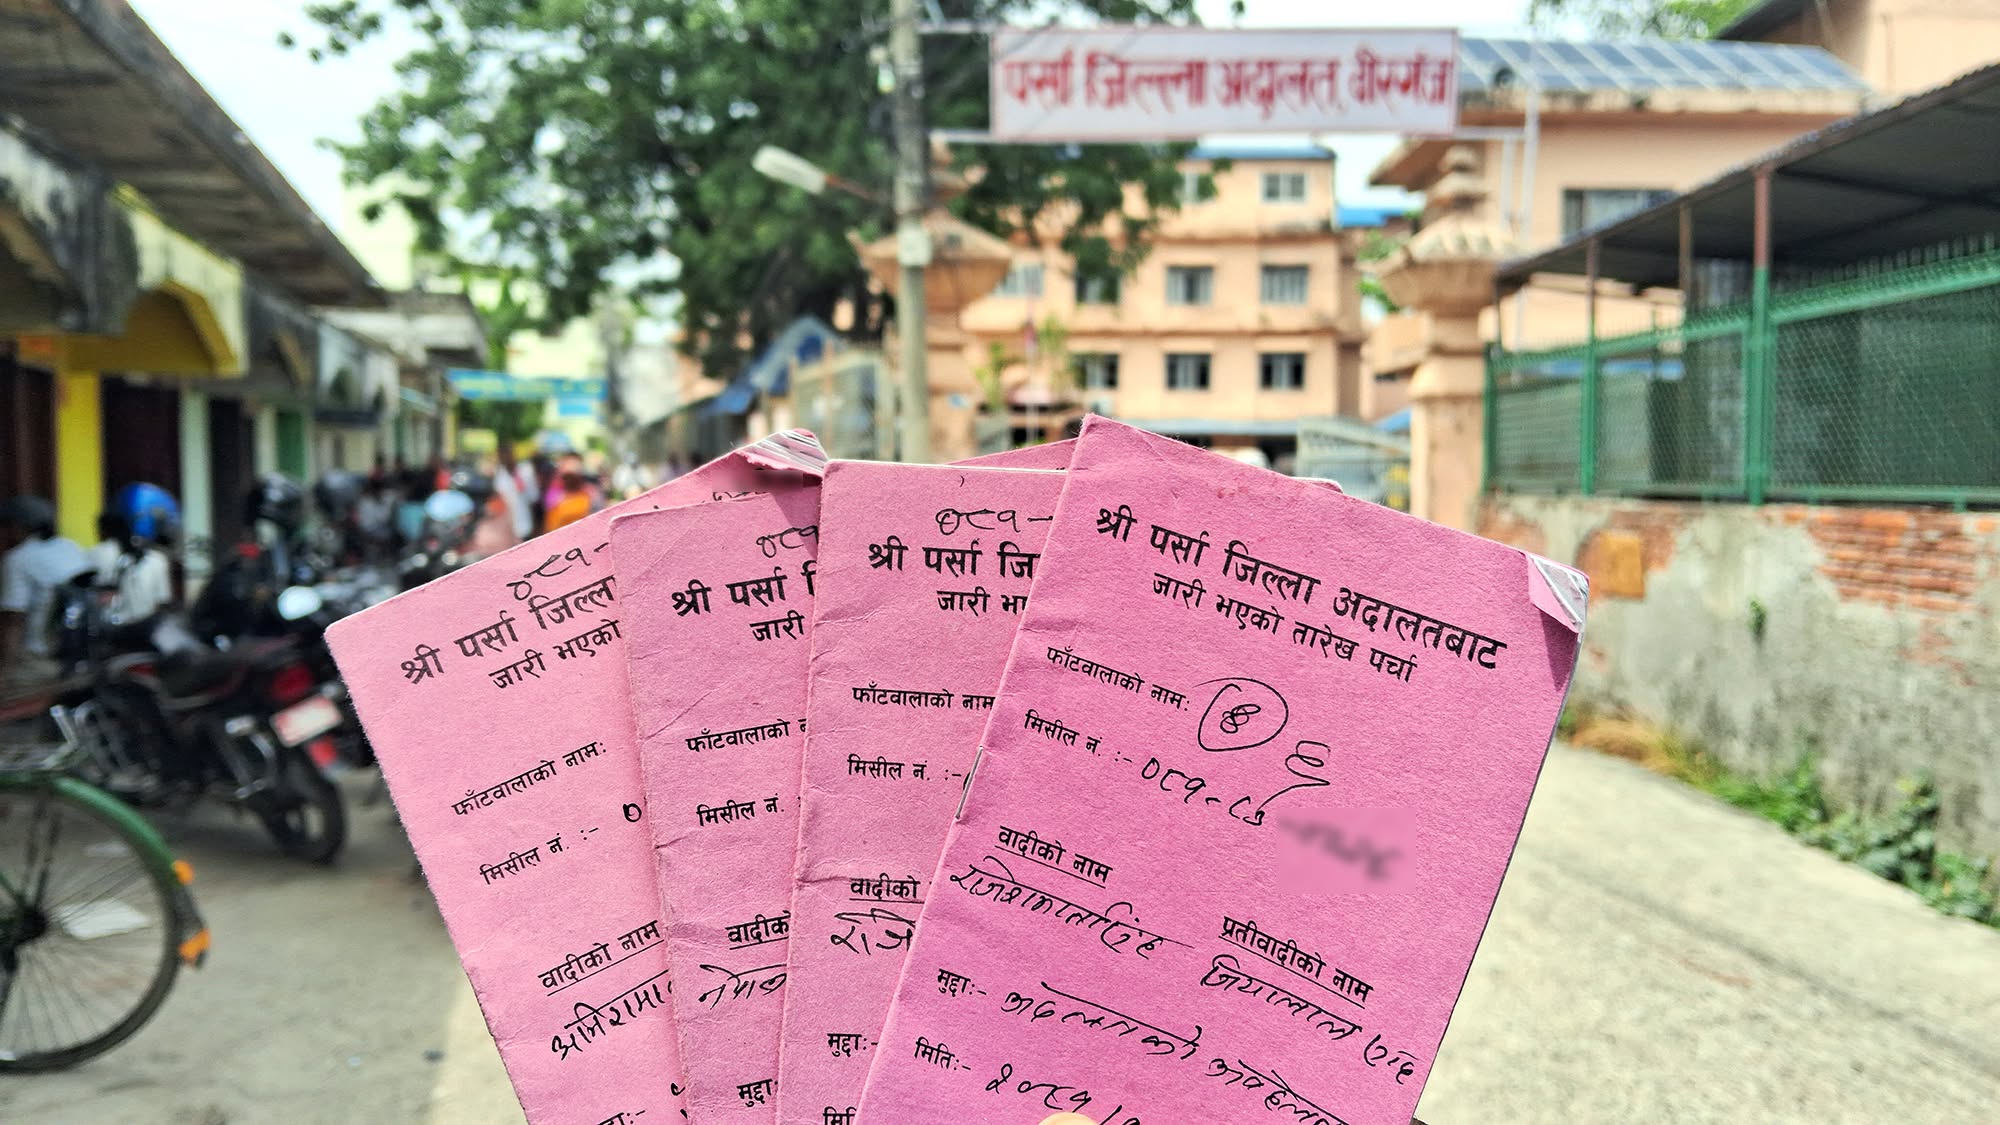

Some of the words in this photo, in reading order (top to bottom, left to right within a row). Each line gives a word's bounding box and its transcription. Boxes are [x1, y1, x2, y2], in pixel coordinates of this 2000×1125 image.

[1085, 51, 1208, 112] जिल्ला
[867, 535, 909, 571] श्री
[922, 537, 983, 577] पर्सा
[671, 579, 712, 617] श्री
[725, 566, 788, 607] पर्सा
[936, 586, 991, 616] जारी
[1097, 504, 1137, 543] श्री
[1148, 525, 1210, 568] पर्सा
[1222, 539, 1321, 604] जिल्ला
[1332, 585, 1508, 670] अदालतबाट
[400, 643, 444, 686] श्री
[453, 610, 520, 659] पर्सा
[749, 609, 805, 642] जारी
[1153, 571, 1207, 609] जारी
[1215, 593, 1284, 636] भएको
[1291, 621, 1360, 660] तारेख
[1370, 648, 1418, 684] पर्चा
[488, 648, 547, 690] जारी
[552, 618, 622, 660] भएको
[1046, 645, 1146, 694] फाँटवालाको
[852, 680, 954, 709] फाँटवालाको
[685, 718, 791, 753] फाँटवालाको
[1023, 708, 1081, 747] मिसील
[450, 759, 559, 816] फाँटवालाको
[847, 753, 905, 781] मिसील
[696, 799, 756, 827] मिसील
[479, 846, 541, 885] मिसील
[998, 825, 1067, 867] वादीको
[1073, 853, 1114, 884] नाम
[850, 873, 921, 900] वादीको
[537, 942, 613, 990] वादीको
[617, 919, 661, 951] नाम
[1220, 915, 1328, 980] प्रतीवादीको
[1332, 967, 1375, 1004] नाम
